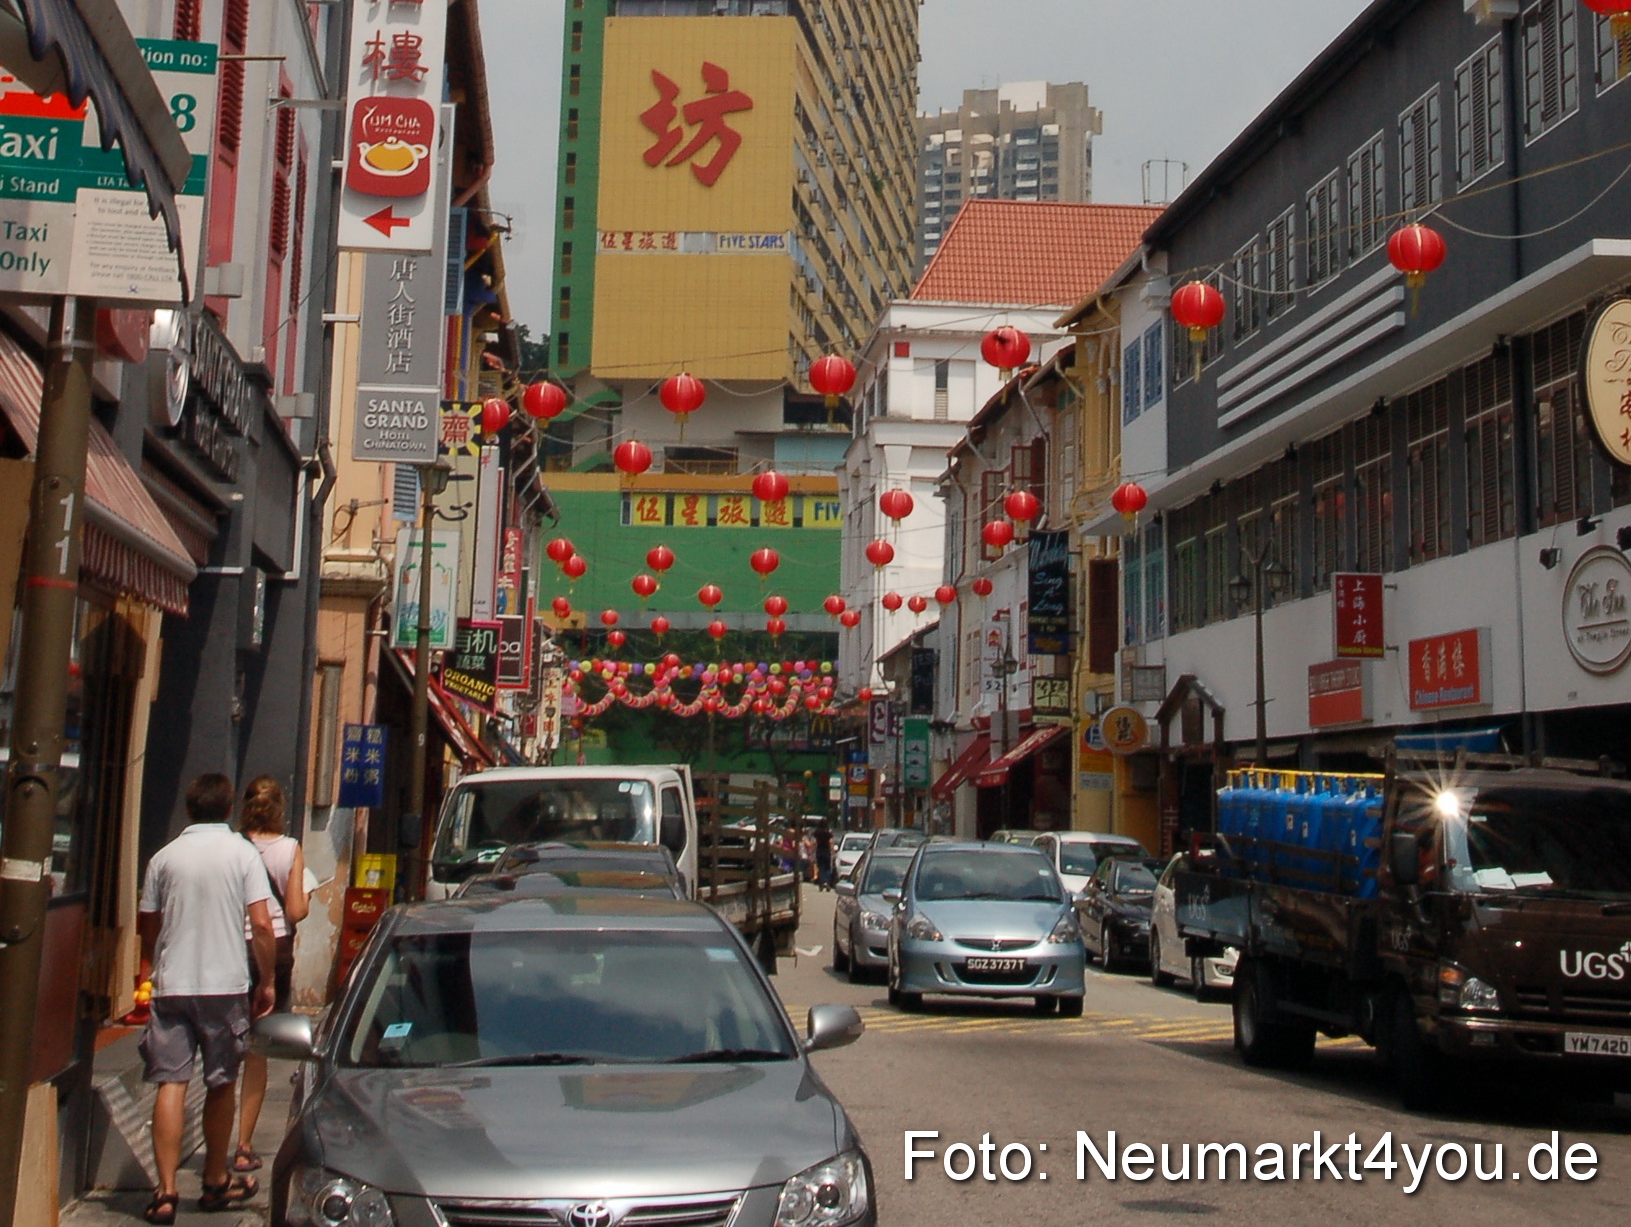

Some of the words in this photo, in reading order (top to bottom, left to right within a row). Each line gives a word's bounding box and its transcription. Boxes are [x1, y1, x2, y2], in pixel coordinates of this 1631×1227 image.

[140, 46, 174, 64] tion
[180, 53, 208, 67] no:
[10, 176, 60, 194] Stand
[3, 220, 48, 242] Taxi
[748, 235, 785, 249] STARS
[0, 251, 50, 277] Only
[385, 258, 417, 374] 唐人街酒店
[368, 399, 426, 414] SANTA
[364, 414, 429, 429] GRAND
[814, 501, 842, 521] FIV
[444, 668, 496, 696] ORGANIC
[444, 679, 488, 703] VEGETABLE
[1560, 949, 1625, 980] UGS
